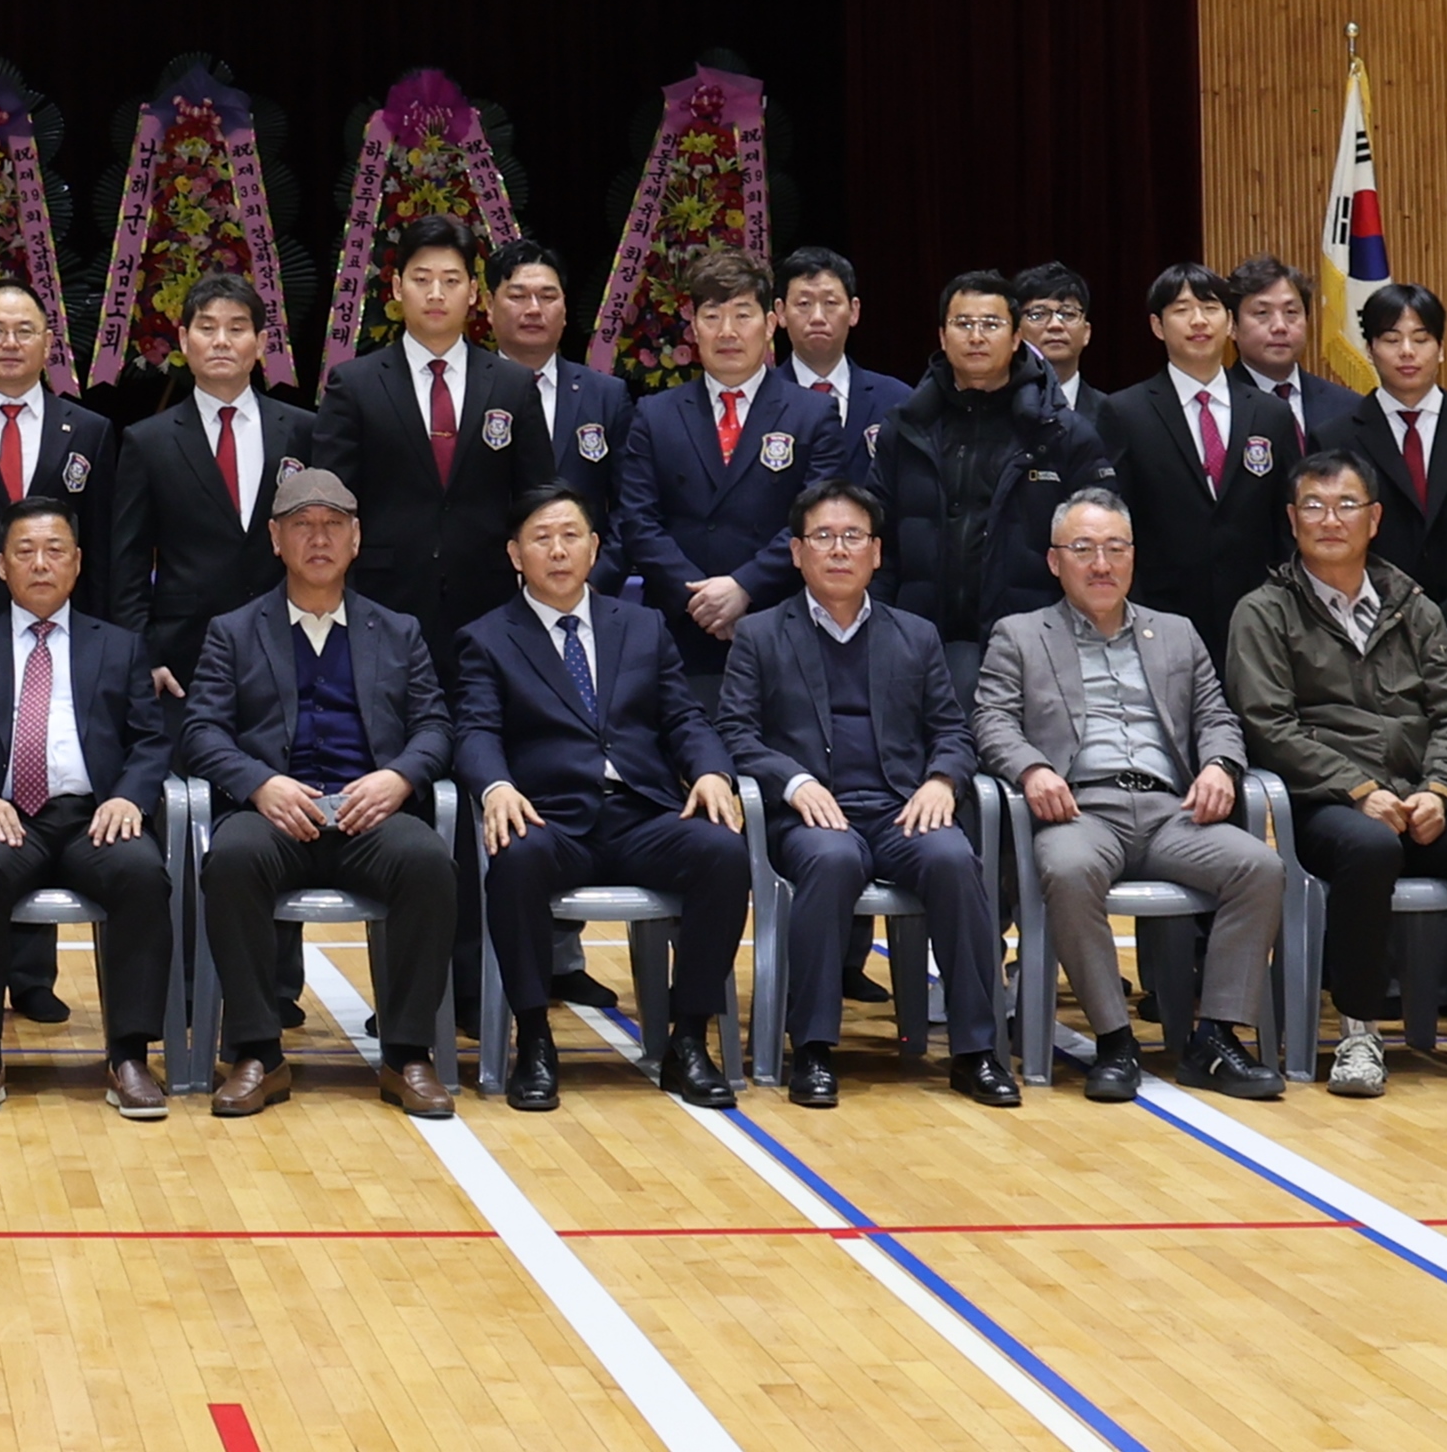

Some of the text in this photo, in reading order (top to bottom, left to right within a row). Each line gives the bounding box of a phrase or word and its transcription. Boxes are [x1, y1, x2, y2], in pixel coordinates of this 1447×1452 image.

[353, 140, 384, 230] 하동주류
[631, 133, 677, 238] 하동군체육회
[102, 138, 156, 355] 남해군 검도회
[332, 277, 358, 347] 최성태
